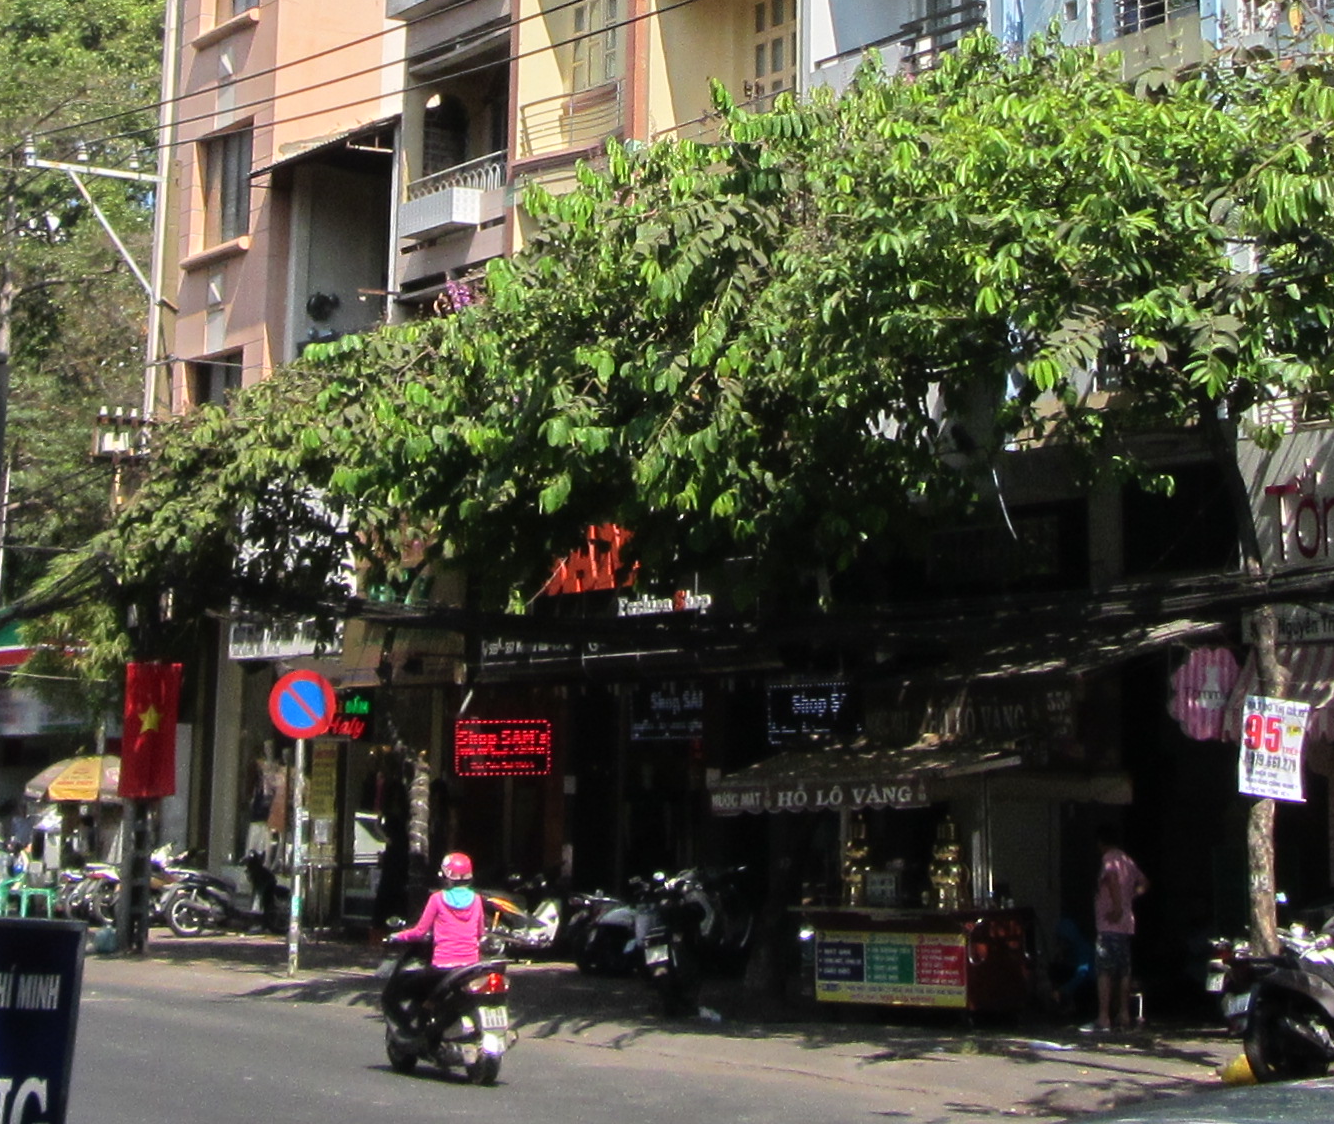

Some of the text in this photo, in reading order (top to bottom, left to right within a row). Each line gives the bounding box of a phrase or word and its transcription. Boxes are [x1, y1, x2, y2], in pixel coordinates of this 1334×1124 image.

[674, 589, 712, 614] Shop
[1244, 713, 1283, 753] 95
[777, 783, 808, 807] HỒ
[815, 784, 844, 805] LÔ
[851, 783, 913, 804] VÀNG
[15, 973, 61, 1010] MINH
